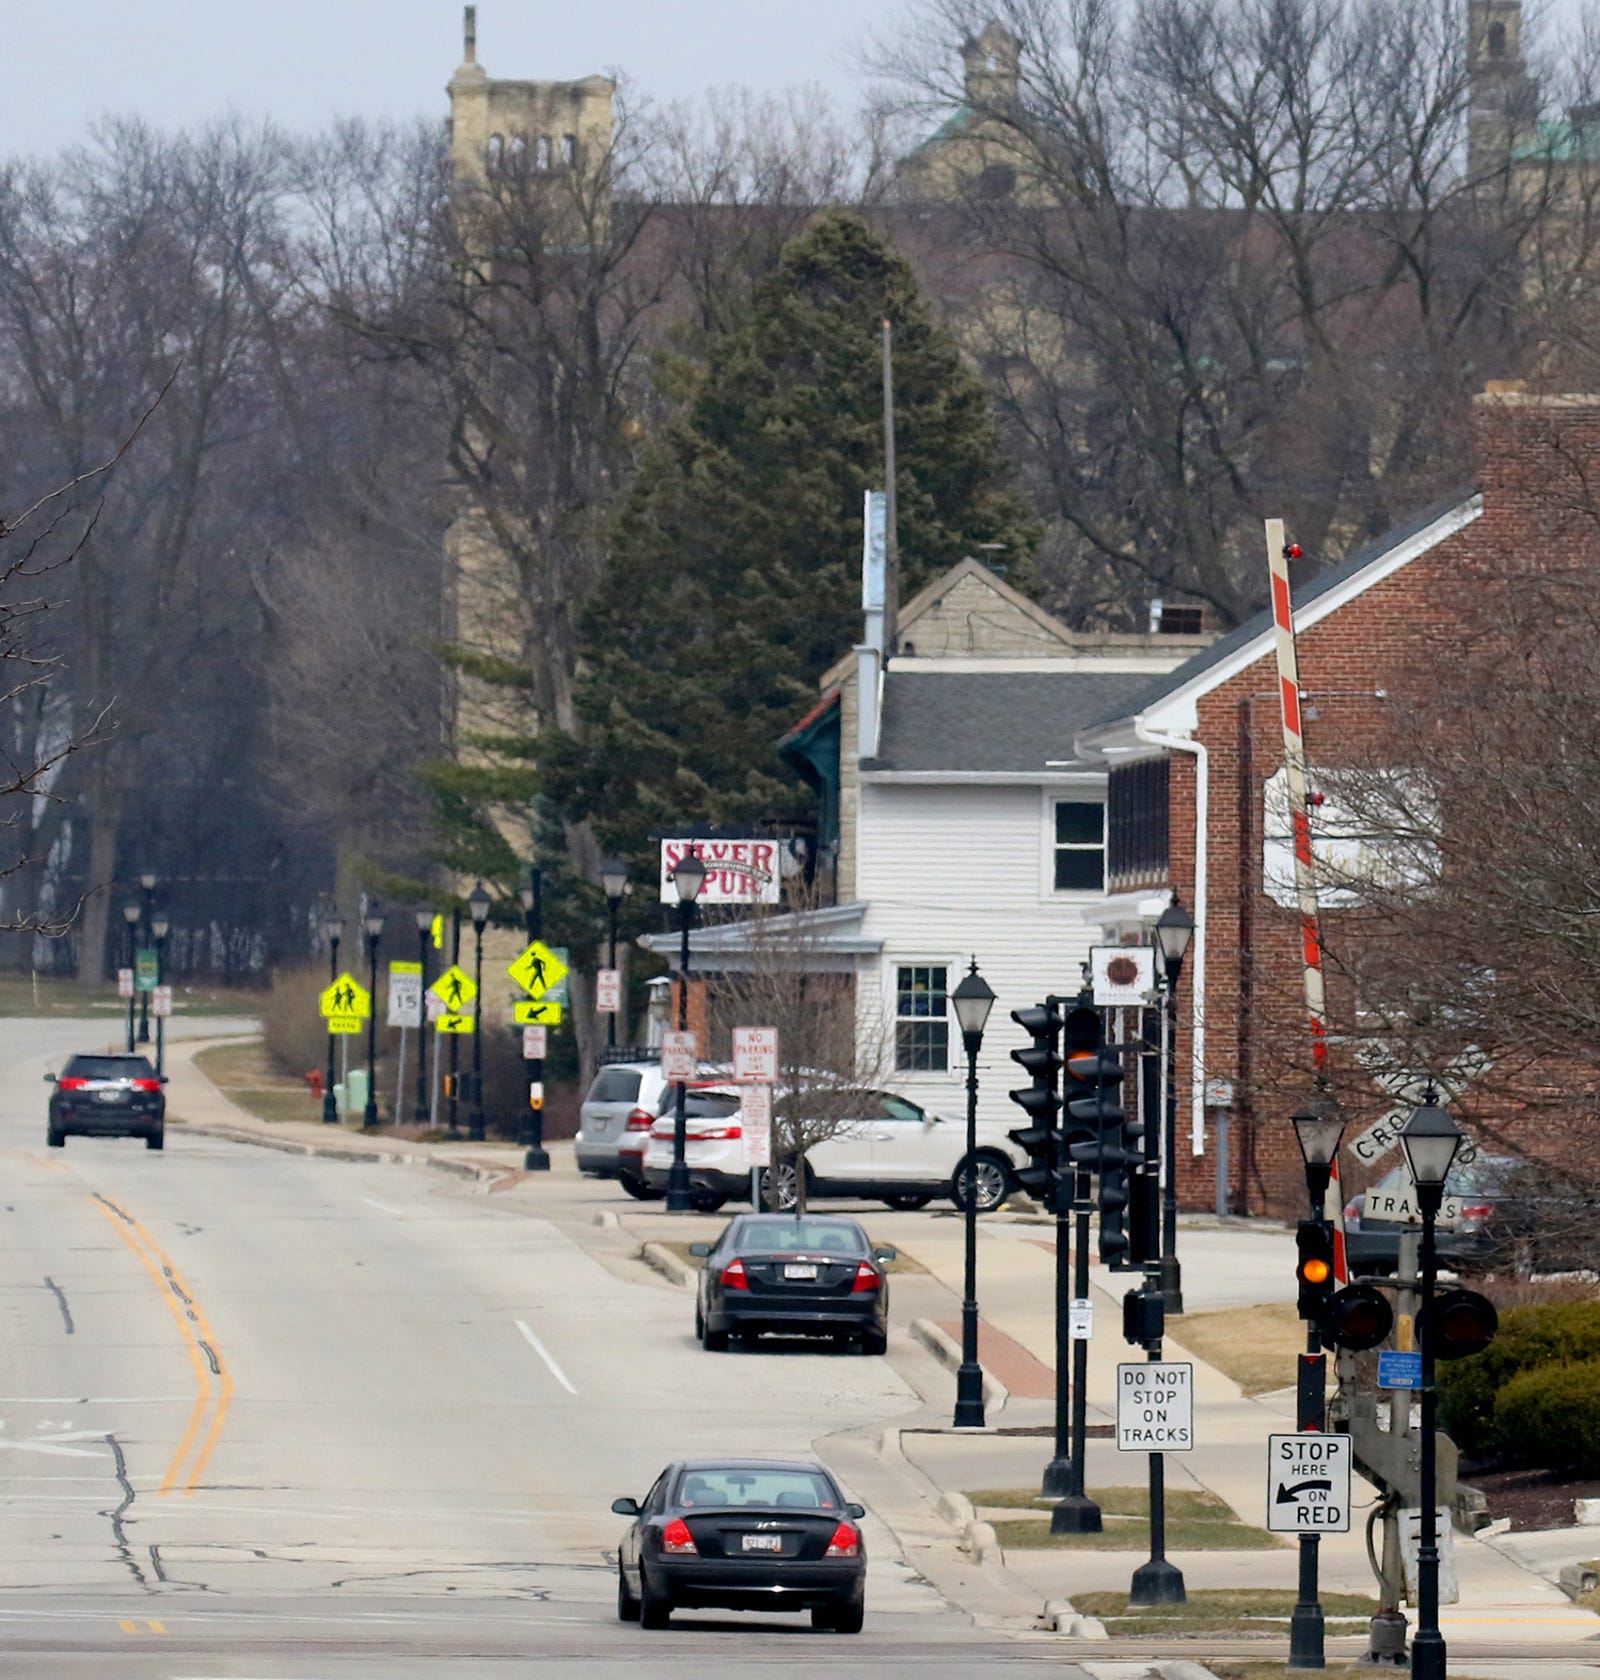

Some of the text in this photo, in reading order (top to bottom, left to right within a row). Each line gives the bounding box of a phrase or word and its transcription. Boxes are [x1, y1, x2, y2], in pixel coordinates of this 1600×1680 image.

[699, 868, 762, 895] PUR
[396, 994, 417, 1009] 15
[748, 1033, 762, 1043] NO
[1371, 1196, 1456, 1219] TRAS
[1124, 1372, 1185, 1385] DO NOT
[1133, 1390, 1177, 1403] STOP
[1143, 1410, 1167, 1422] ON
[1124, 1428, 1188, 1442] TRACKS
[1281, 1442, 1340, 1461] STOP
[1291, 1464, 1328, 1476] HERE
[1309, 1490, 1328, 1502] ON
[1297, 1506, 1341, 1525] RED
